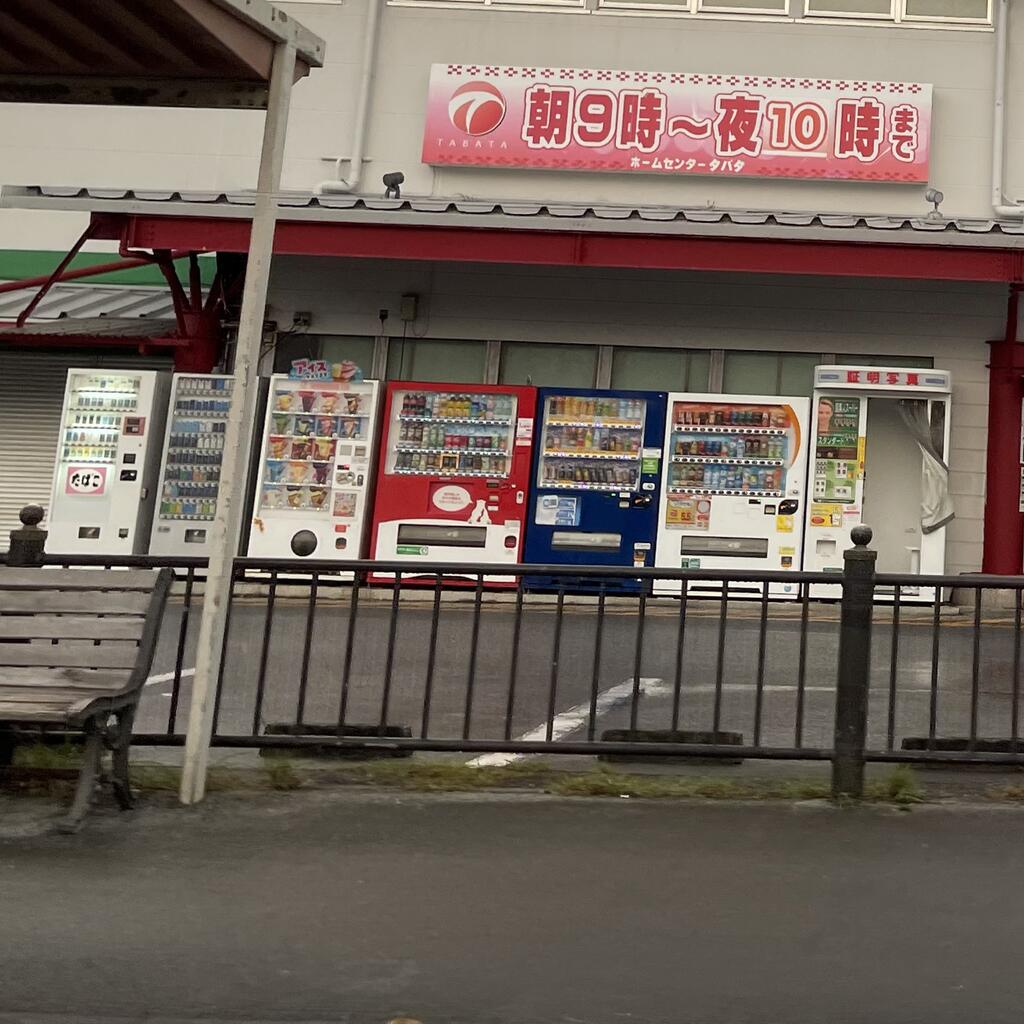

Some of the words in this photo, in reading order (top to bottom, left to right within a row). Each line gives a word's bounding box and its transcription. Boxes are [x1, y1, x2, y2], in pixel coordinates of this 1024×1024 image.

[437, 138, 508, 149] TABATA
[292, 359, 327, 375] アイス
[846, 370, 919, 385] 証明写真
[71, 473, 100, 487] たばこ
